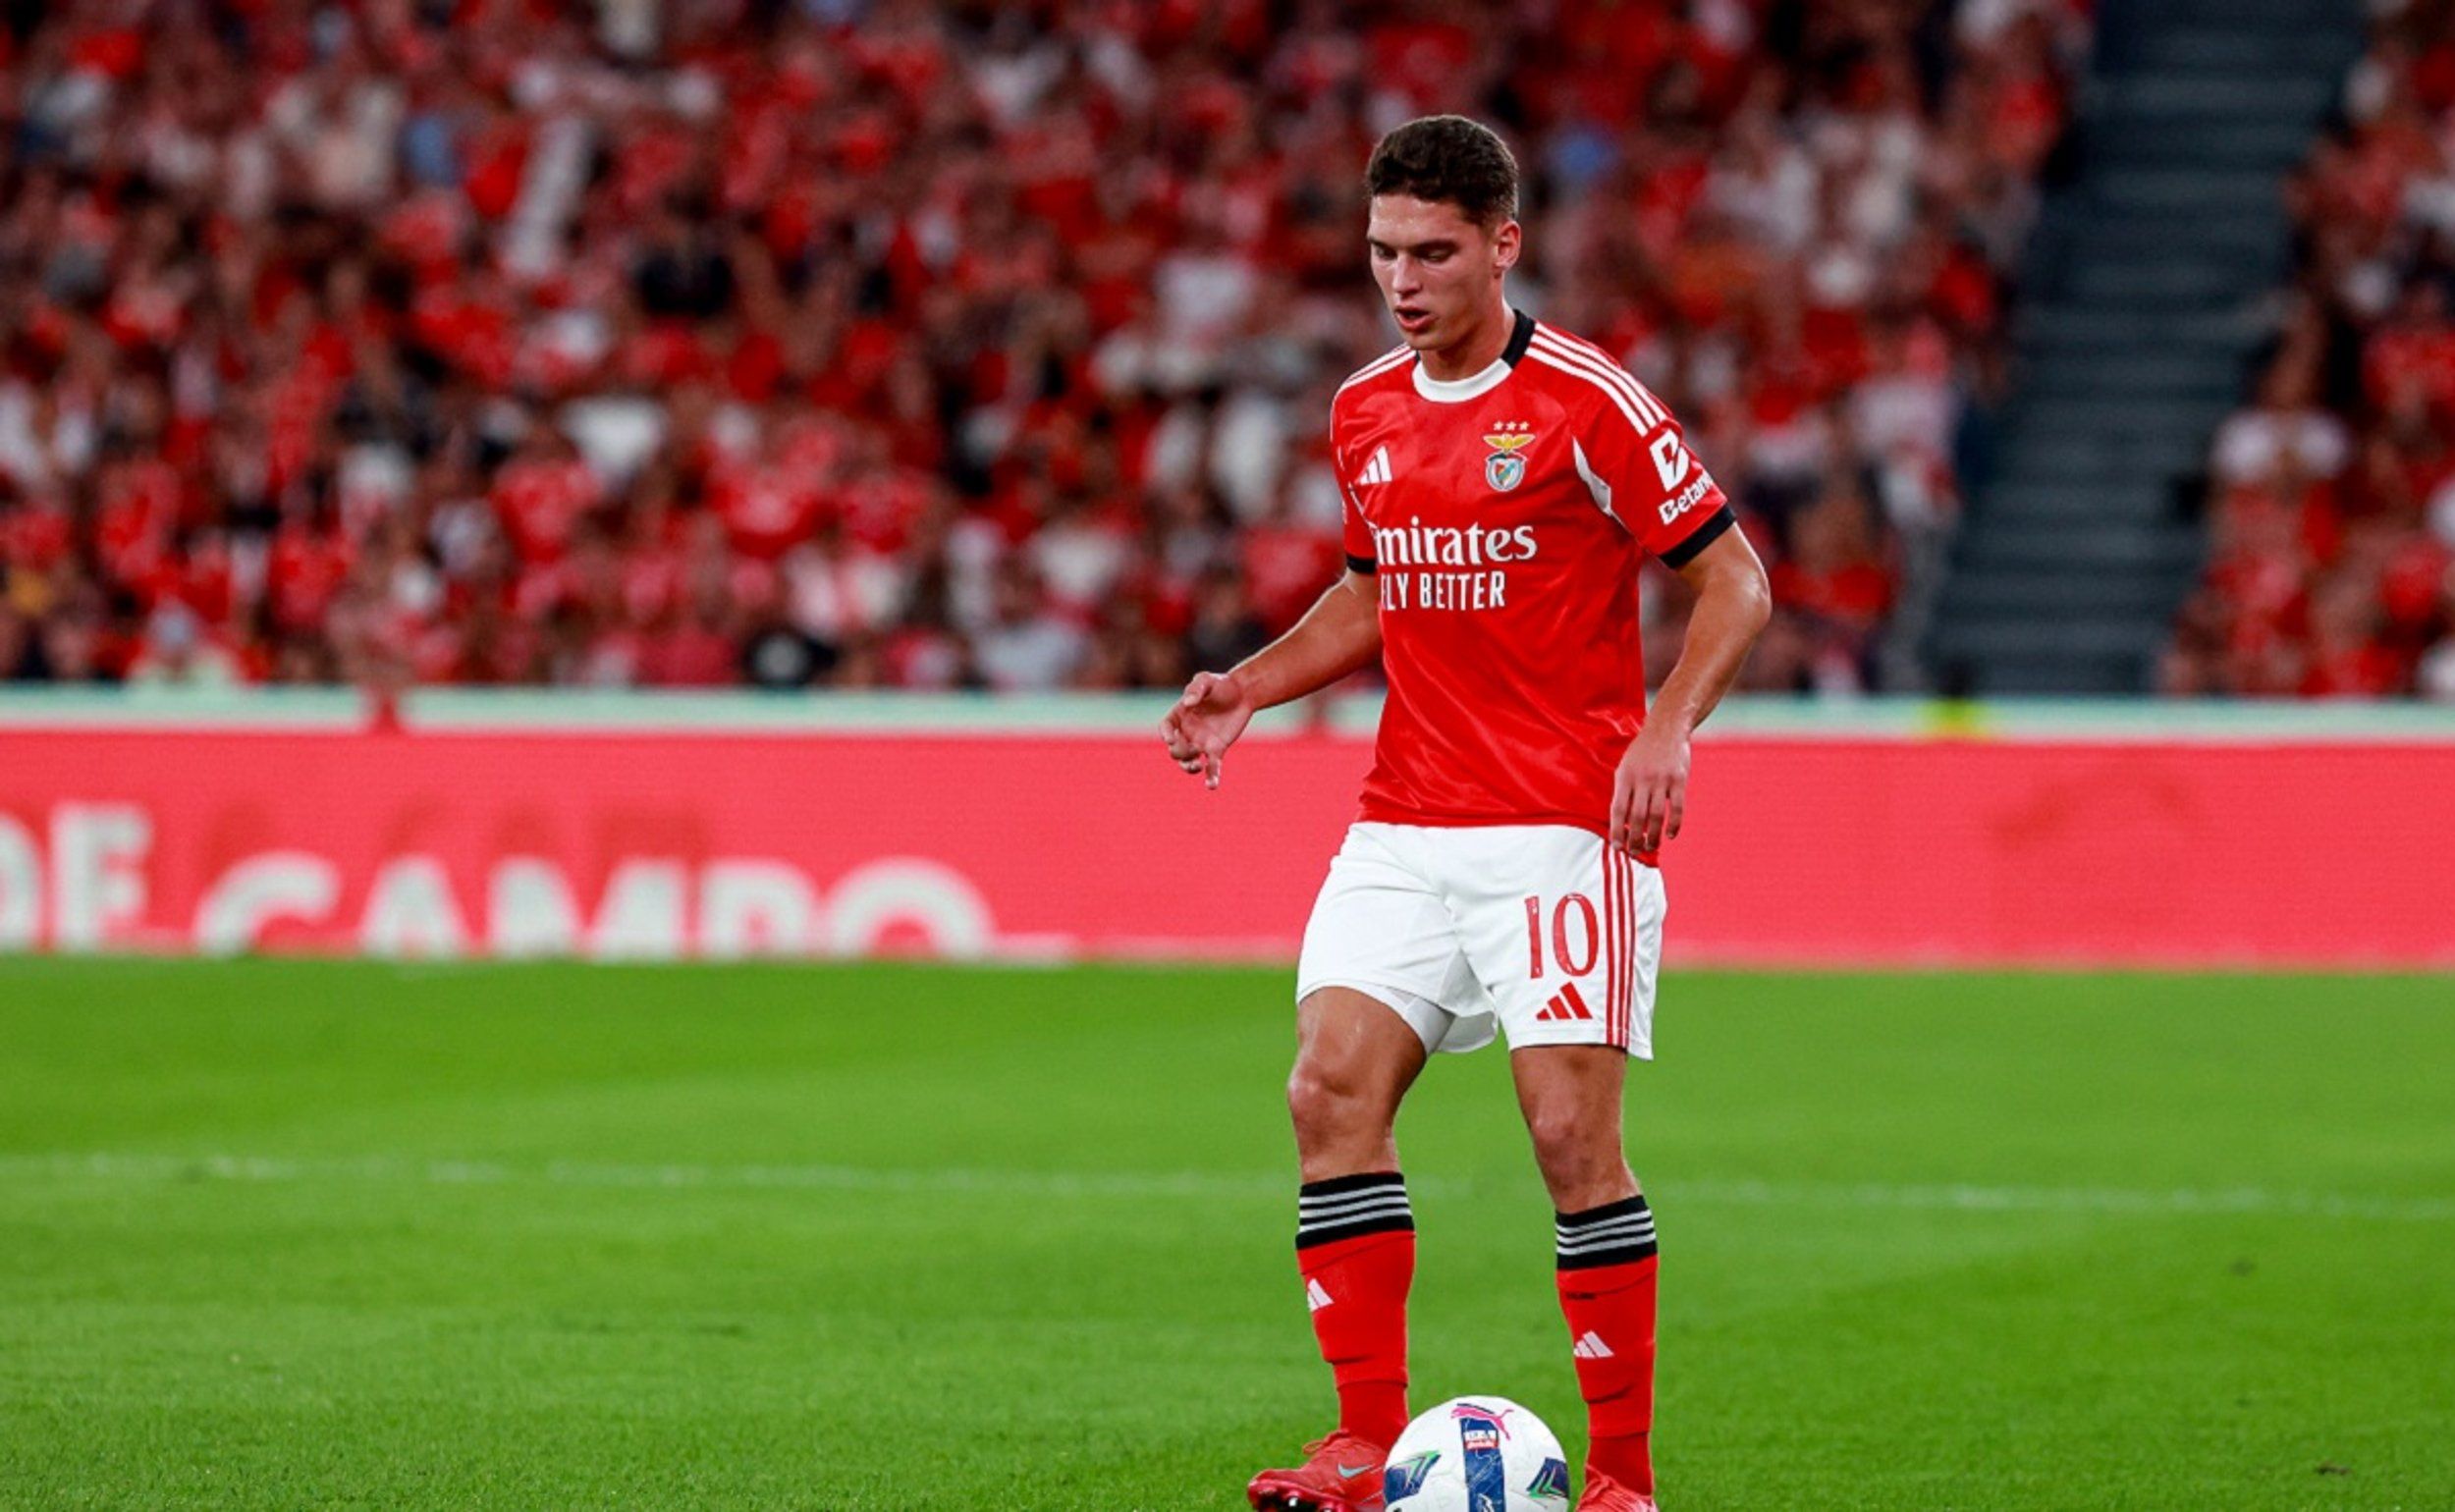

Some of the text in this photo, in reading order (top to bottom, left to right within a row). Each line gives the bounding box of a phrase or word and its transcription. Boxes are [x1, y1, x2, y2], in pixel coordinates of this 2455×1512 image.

[1658, 469, 1715, 525] Betan
[1375, 514, 1538, 567] mirates
[1420, 569, 1506, 612] BETTER
[193, 850, 998, 960] CAMPO
[1524, 892, 1600, 980] 10
